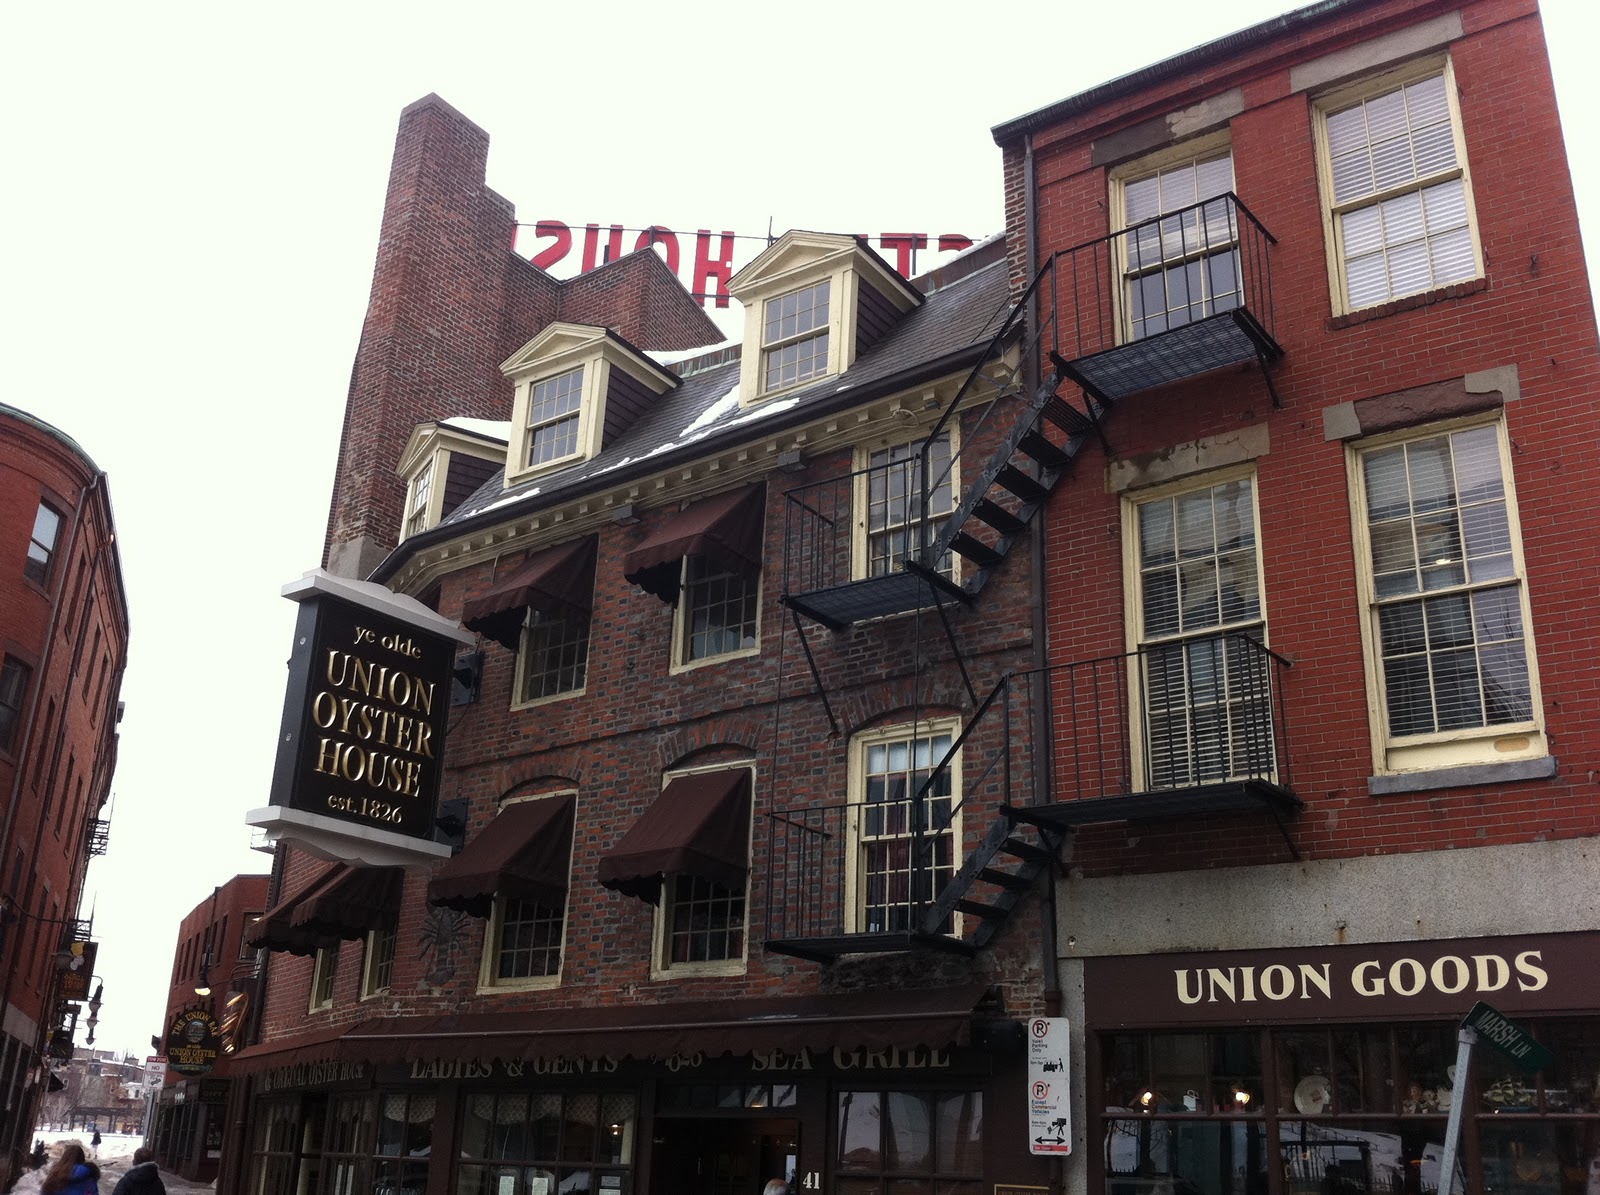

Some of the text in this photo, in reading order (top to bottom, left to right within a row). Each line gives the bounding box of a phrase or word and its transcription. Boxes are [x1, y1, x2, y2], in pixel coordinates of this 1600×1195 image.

[353, 625, 422, 660] ye olde
[327, 649, 436, 716] UNION
[313, 691, 434, 760] OYSTER
[313, 737, 422, 798] HOUSE
[1173, 950, 1549, 1005] UNION GOODS
[171, 1019, 186, 1036] THE
[185, 1011, 212, 1022] UNION
[1474, 1009, 1532, 1058] MARSH LN
[169, 1047, 217, 1058] UNION OYSTER
[179, 1055, 205, 1065] HOUSE
[751, 1044, 950, 1071] SEA GRILL
[802, 1172, 820, 1189] 41
